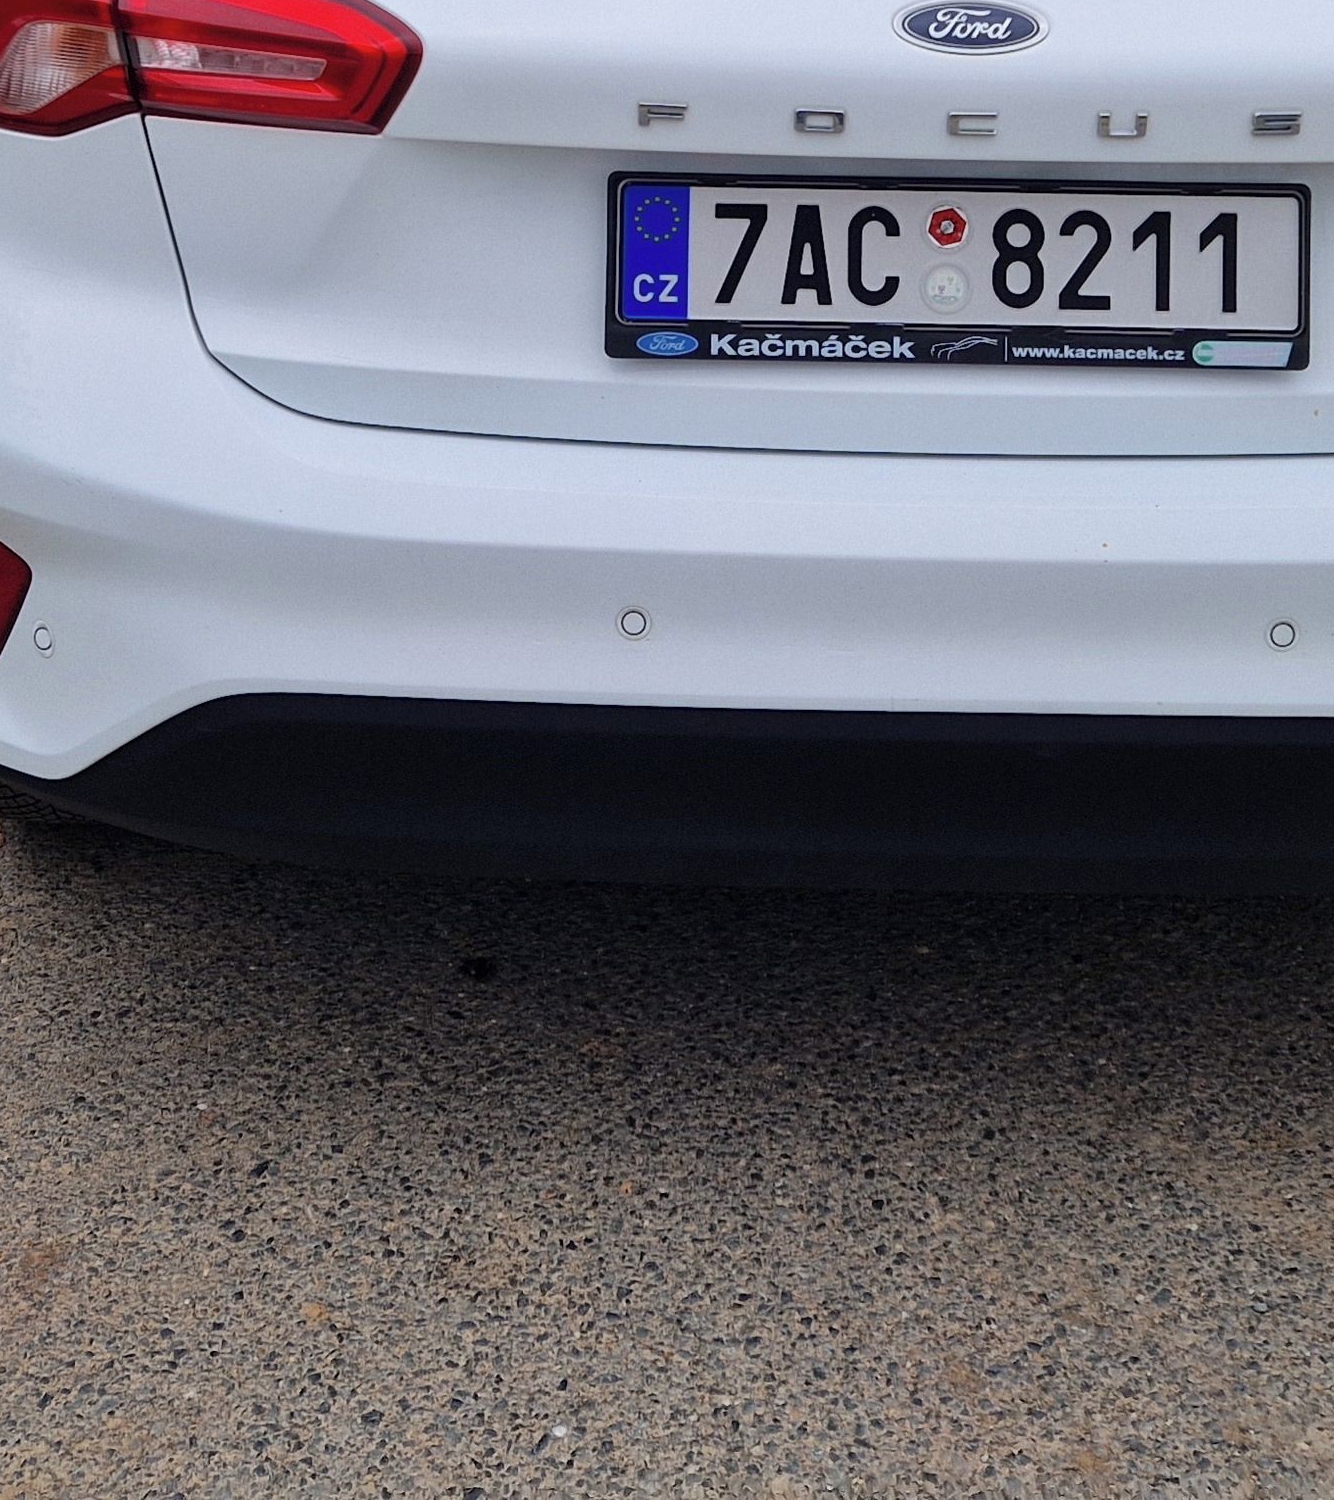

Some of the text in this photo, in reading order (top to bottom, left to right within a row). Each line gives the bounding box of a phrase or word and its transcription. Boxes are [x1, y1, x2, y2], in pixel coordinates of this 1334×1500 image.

[928, 7, 1013, 40] Ford
[637, 102, 1303, 137] FOCUS
[713, 203, 1239, 313] 7AC 8211
[633, 274, 680, 303] CZ
[649, 333, 916, 360] Ford Kačmáček
[1011, 344, 1186, 361] www.kacmacek.cz
